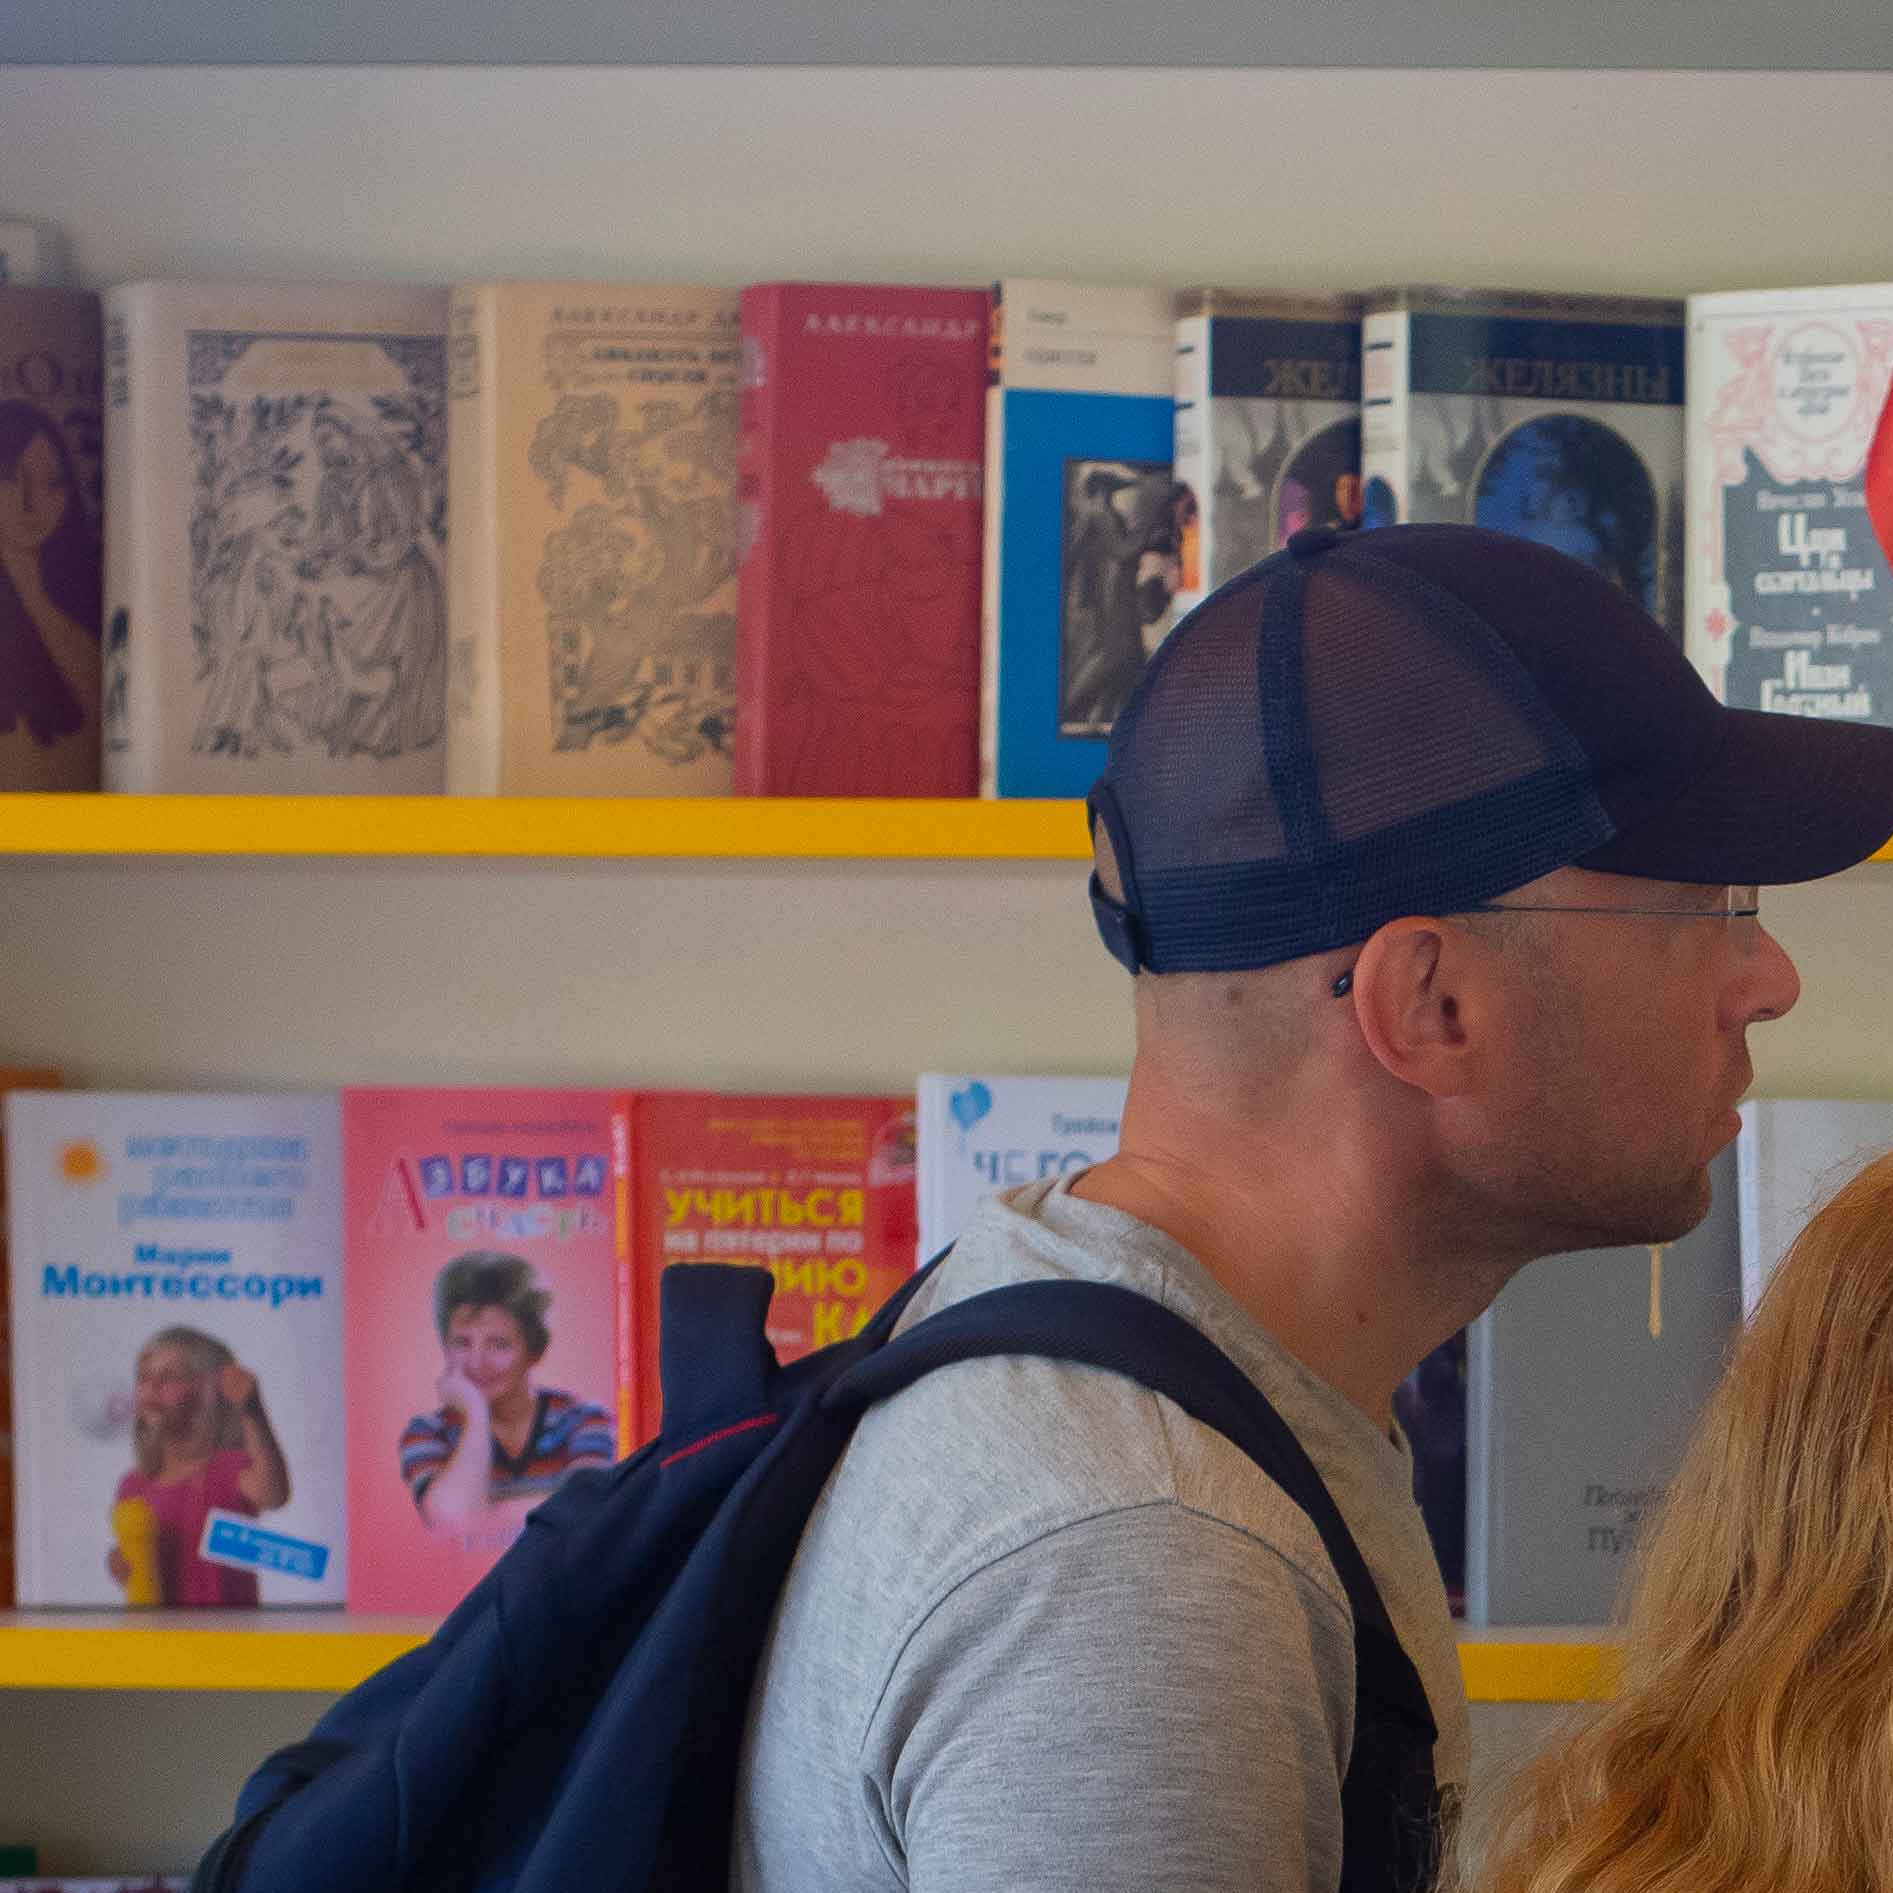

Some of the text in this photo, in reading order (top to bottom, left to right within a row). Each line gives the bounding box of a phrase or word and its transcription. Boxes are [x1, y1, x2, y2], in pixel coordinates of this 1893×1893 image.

[1462, 354, 1670, 402] ЖЕЛЯЗНЫ
[665, 1188, 865, 1227] УЧИТЬСЯ
[42, 1263, 324, 1308] Монтессори
